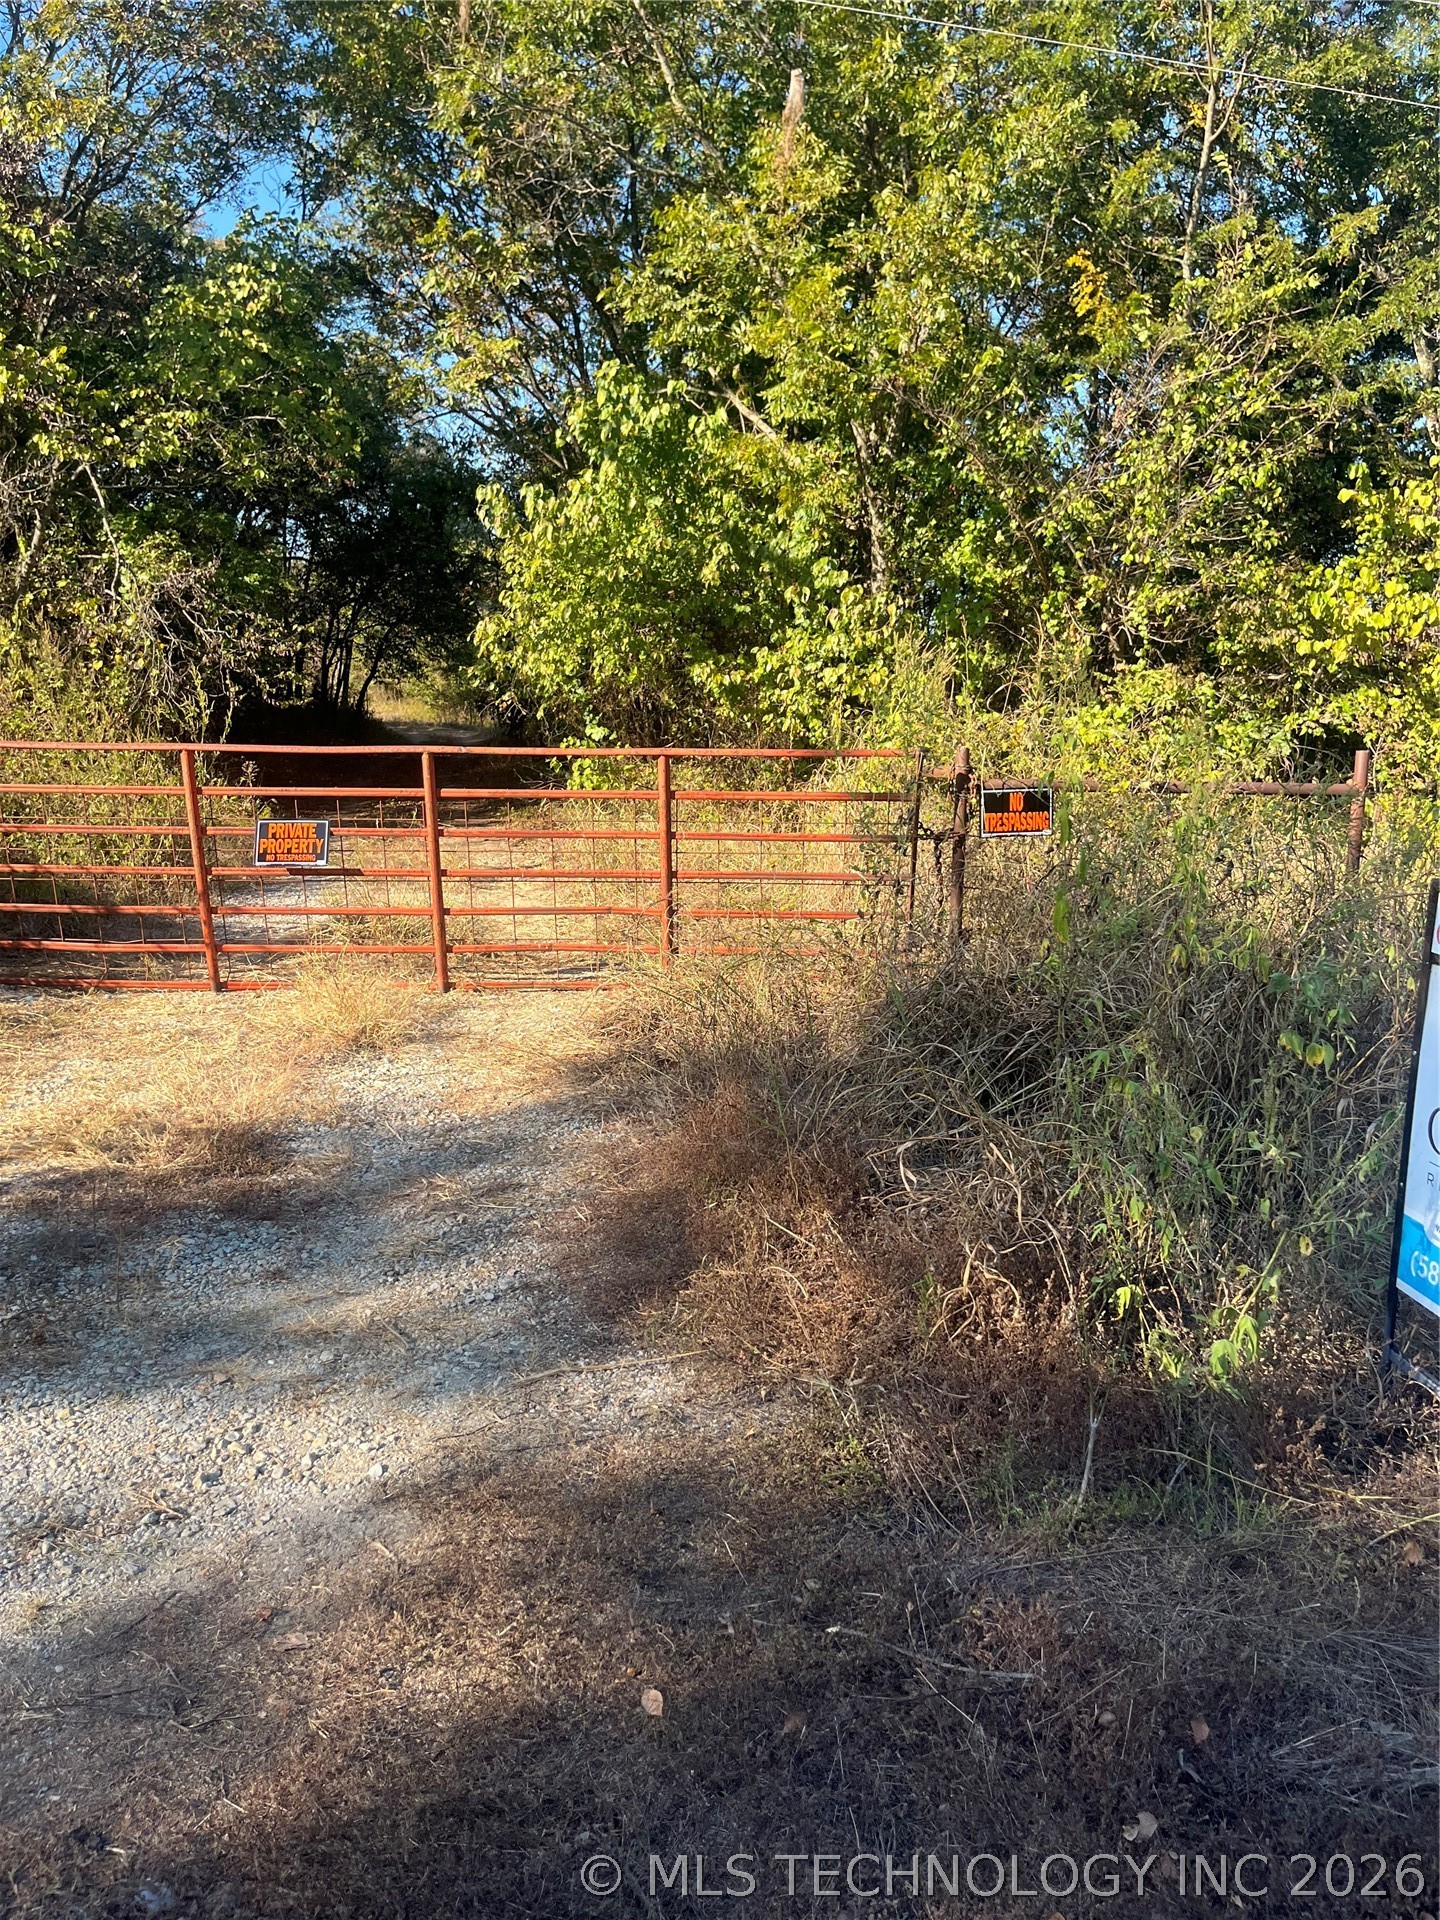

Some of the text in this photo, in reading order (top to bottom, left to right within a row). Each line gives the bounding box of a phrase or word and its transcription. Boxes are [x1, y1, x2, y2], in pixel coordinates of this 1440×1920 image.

[1009, 792, 1024, 812] NO
[984, 811, 1050, 832] TRESPASSING
[268, 823, 317, 839] PRIVATE
[259, 838, 324, 854] PROPERTY
[265, 854, 317, 862] NO TRESPASSING
